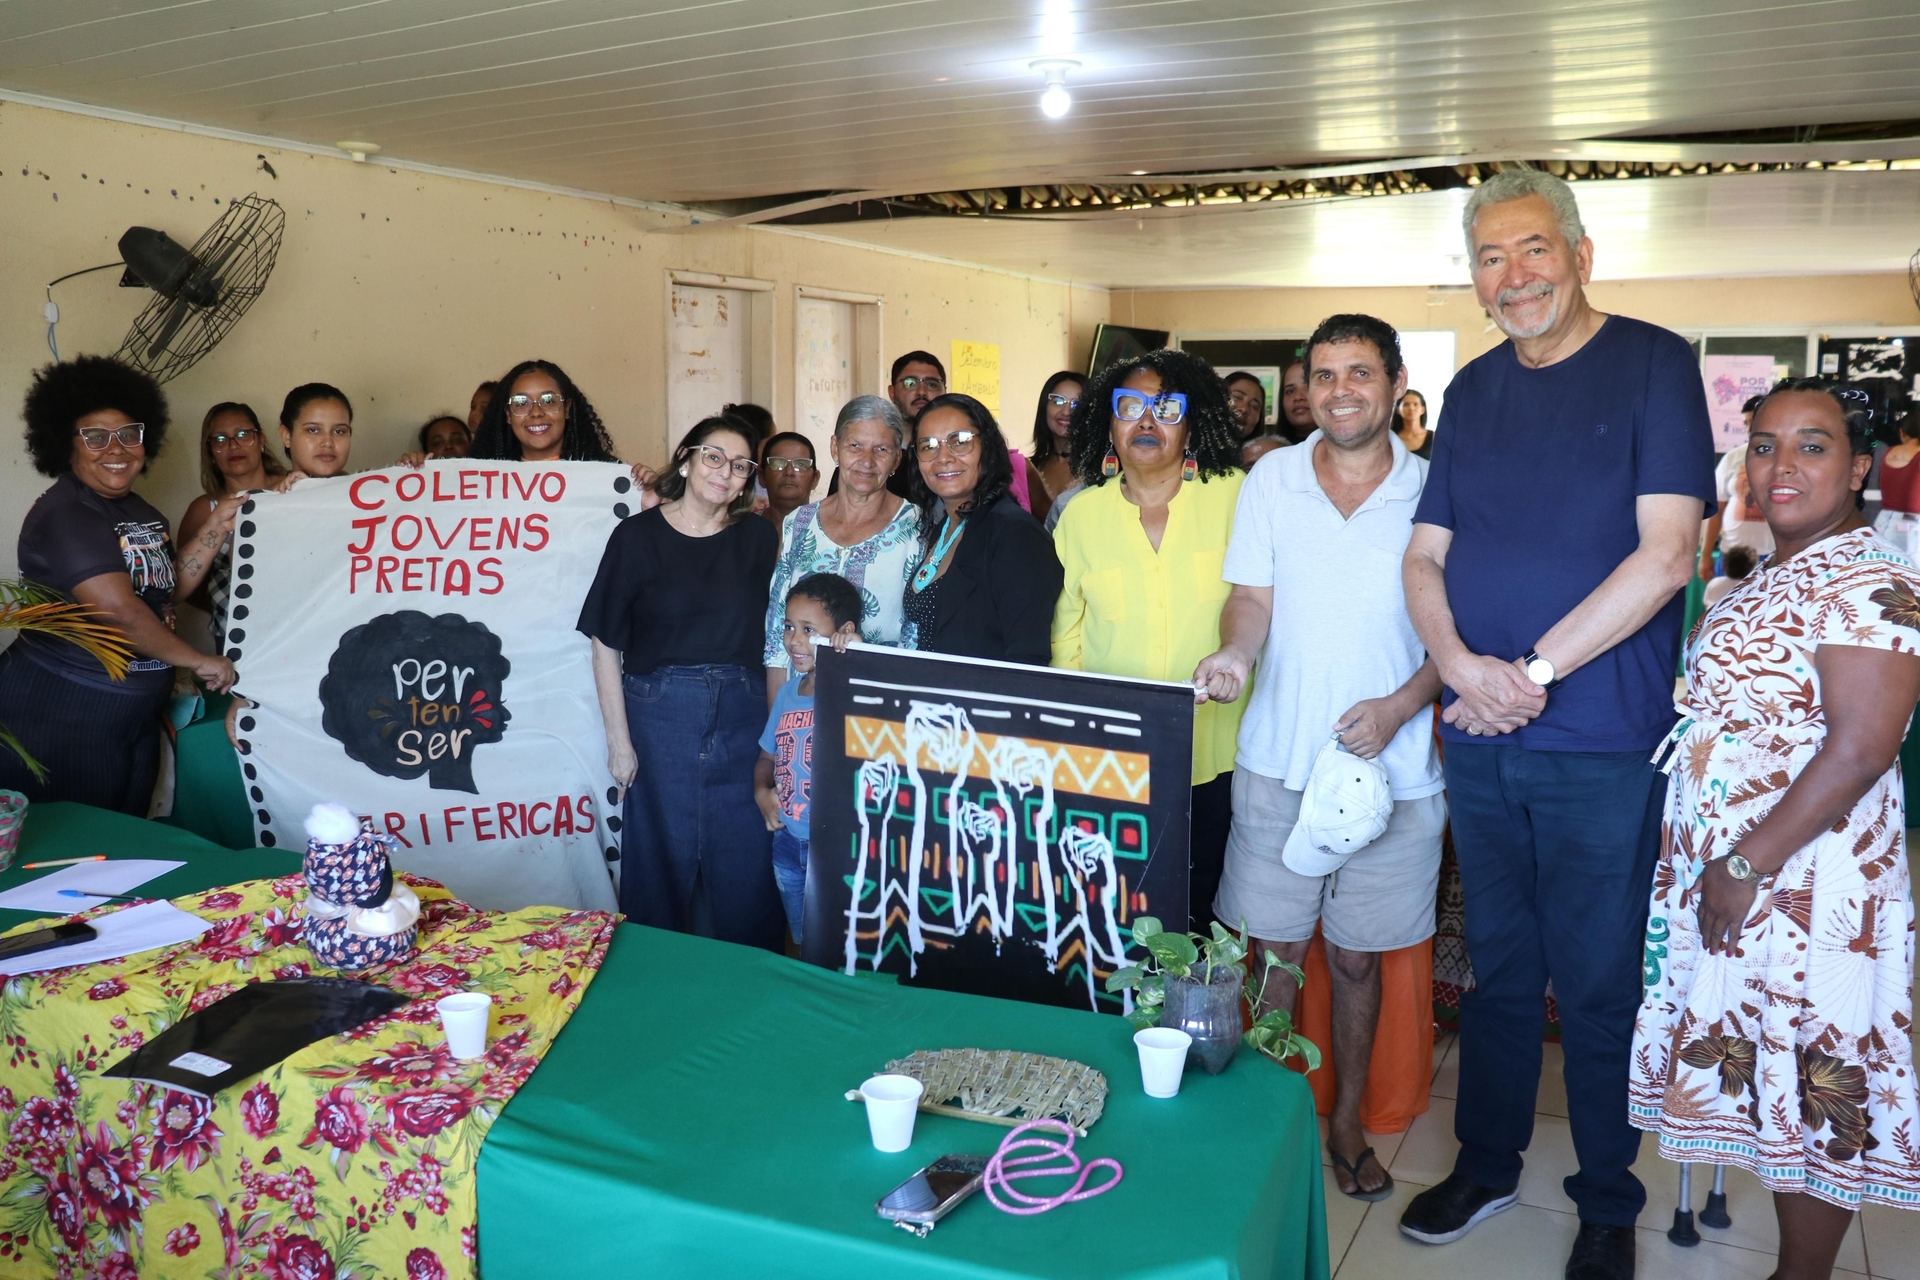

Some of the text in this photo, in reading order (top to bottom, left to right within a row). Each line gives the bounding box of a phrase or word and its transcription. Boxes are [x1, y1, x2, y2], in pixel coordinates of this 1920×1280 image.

[1740, 377, 1766, 386] POR
[349, 470, 566, 510] COLETIVO
[347, 513, 549, 555] JOVENS
[350, 555, 504, 596] PRETAS
[407, 696, 461, 726] ten
[357, 795, 596, 849] RIFERICAS
